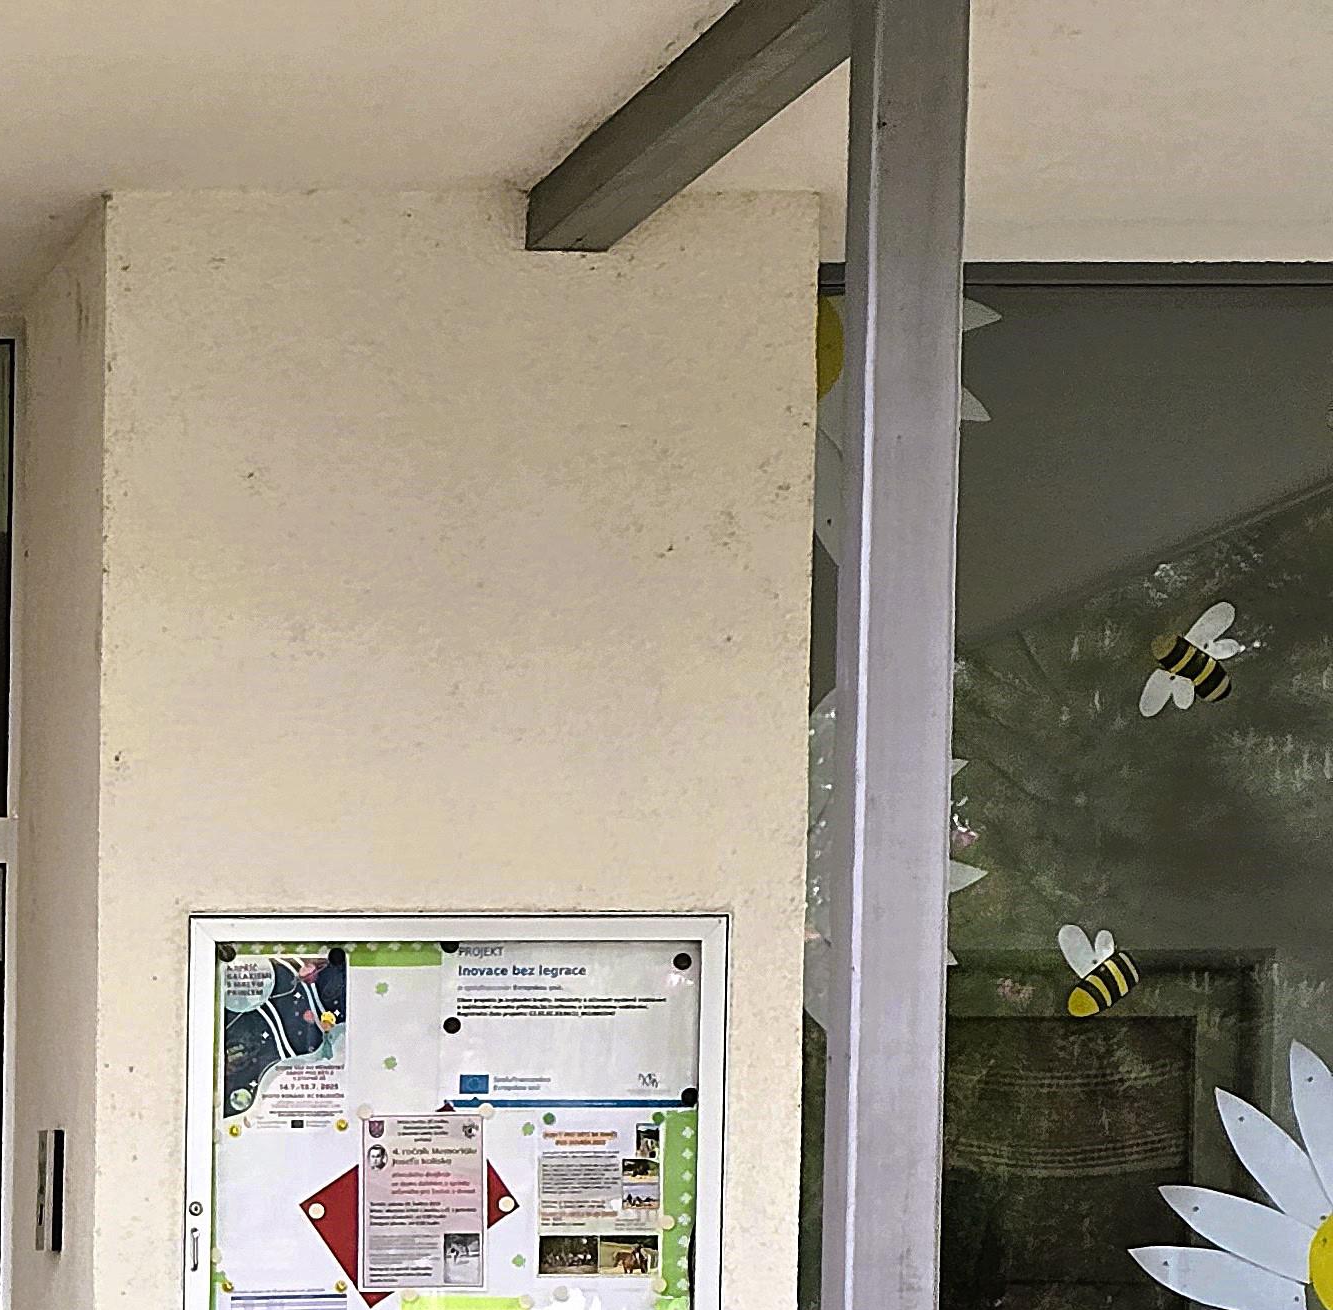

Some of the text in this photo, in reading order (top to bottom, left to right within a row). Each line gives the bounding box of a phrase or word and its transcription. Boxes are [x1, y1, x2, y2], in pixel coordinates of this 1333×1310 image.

[458, 946, 504, 958] PROJEKT
[458, 965, 587, 978] Inovace bez legrace
